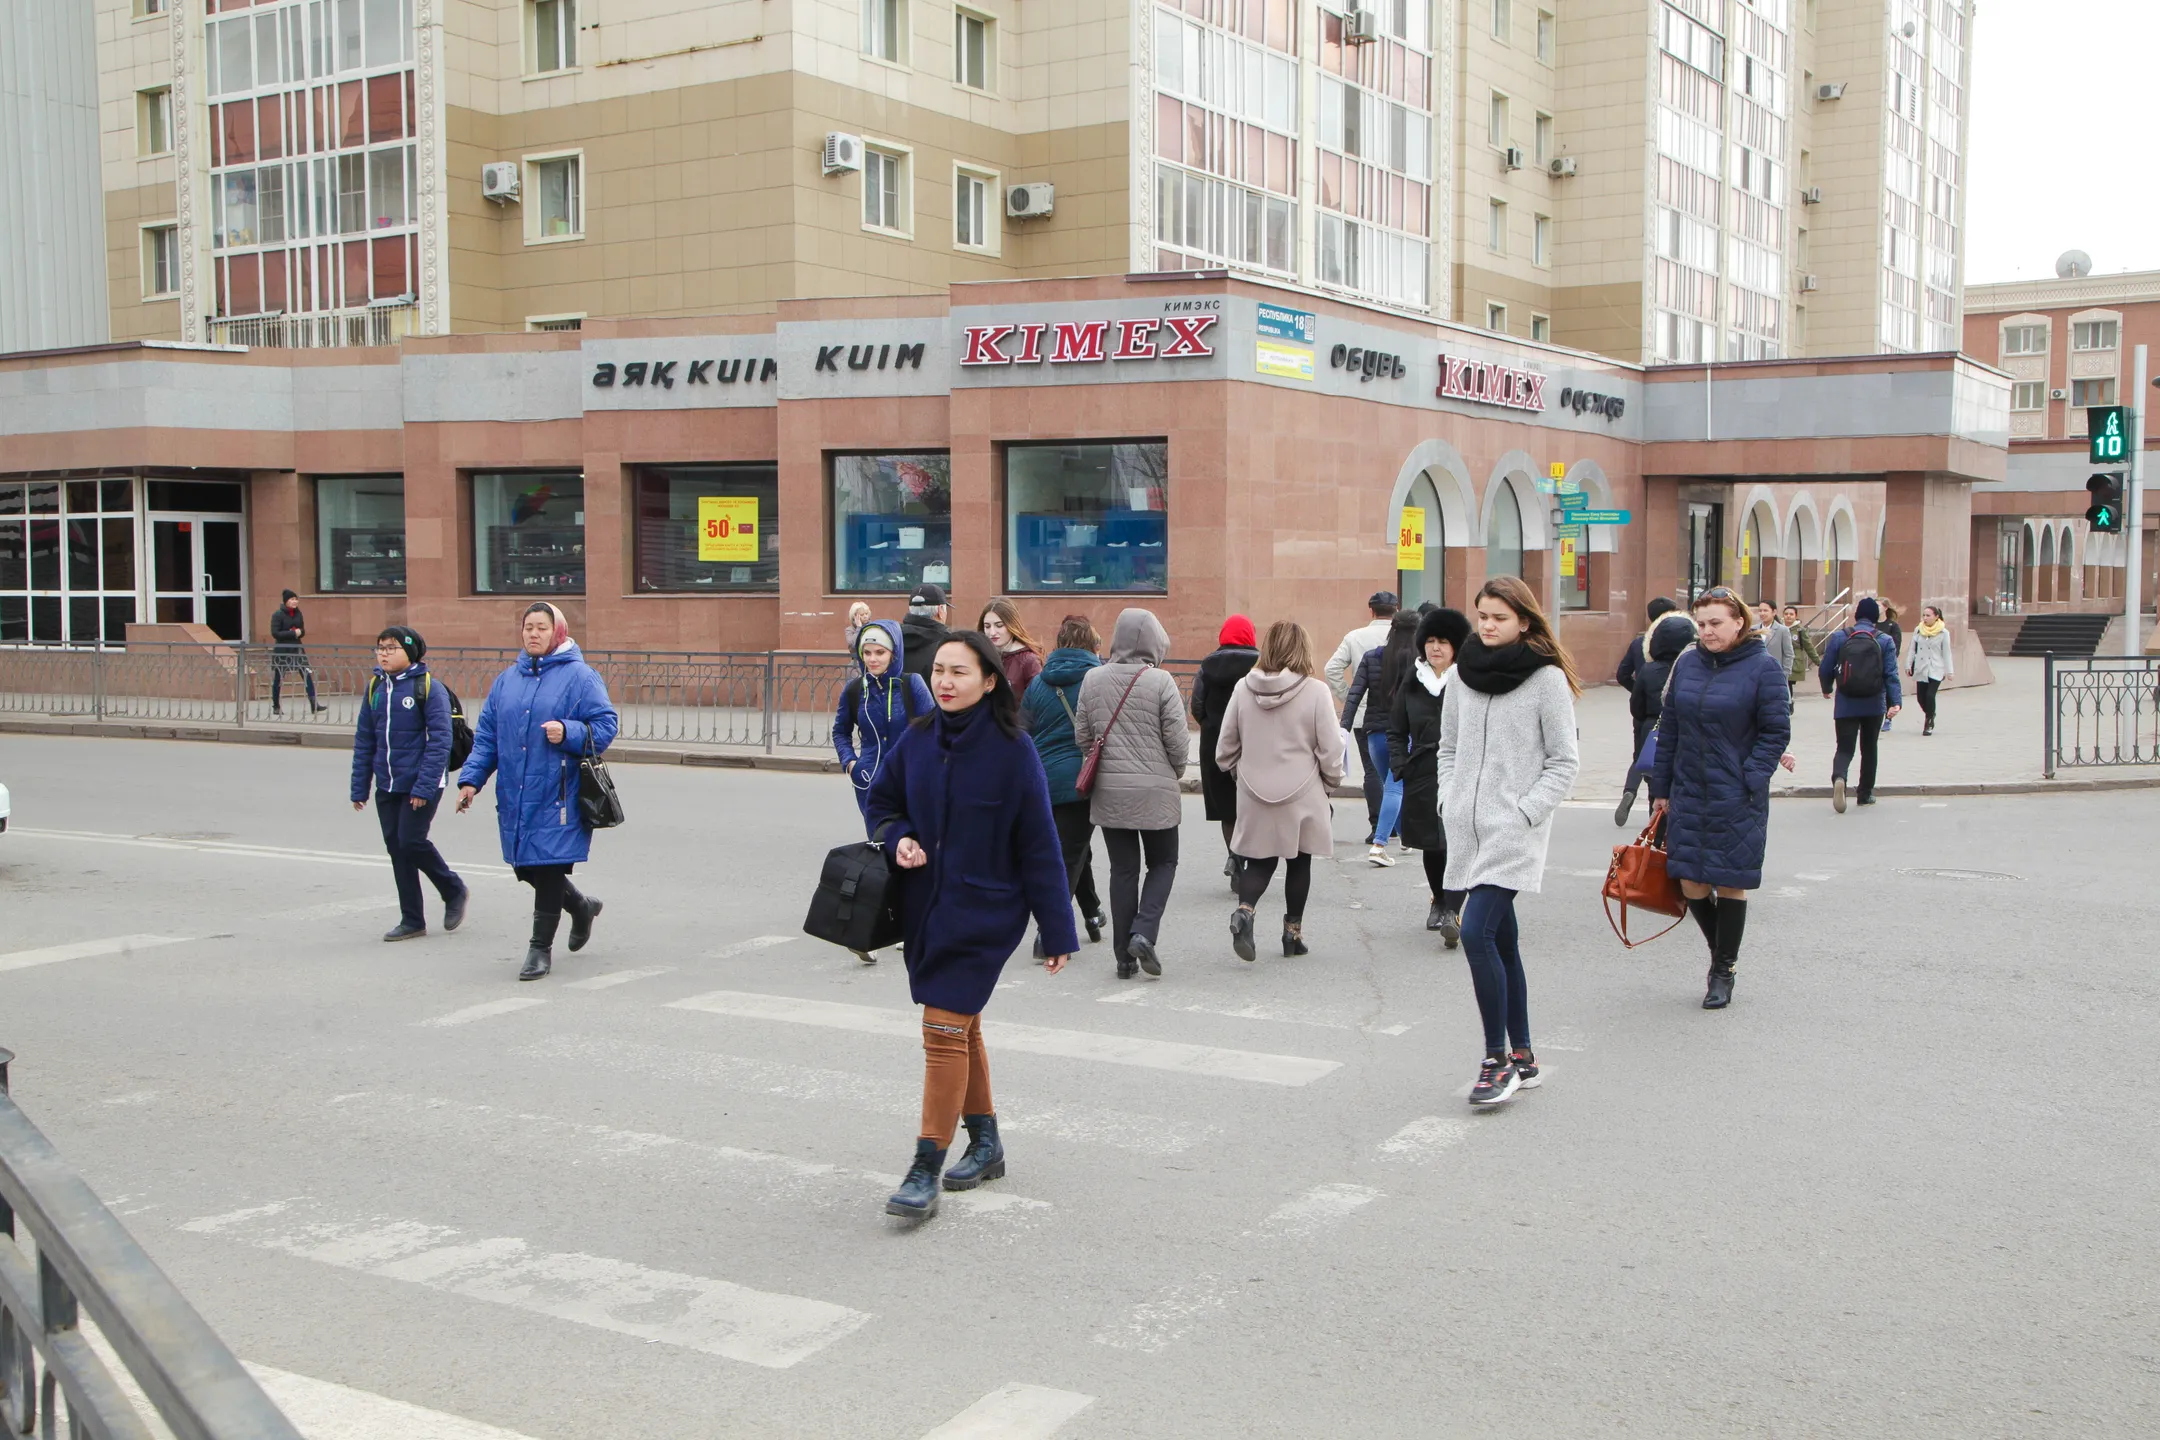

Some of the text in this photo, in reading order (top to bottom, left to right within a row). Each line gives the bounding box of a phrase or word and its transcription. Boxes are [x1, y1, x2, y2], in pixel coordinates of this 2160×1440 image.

[1164, 299, 1221, 313] КИМЭКС
[1258, 307, 1305, 331] РЕСПУБЛИКА 18
[960, 315, 1217, 366] KIMEX
[1439, 353, 1548, 412] KIMEX
[2096, 436, 2121, 456] 10
